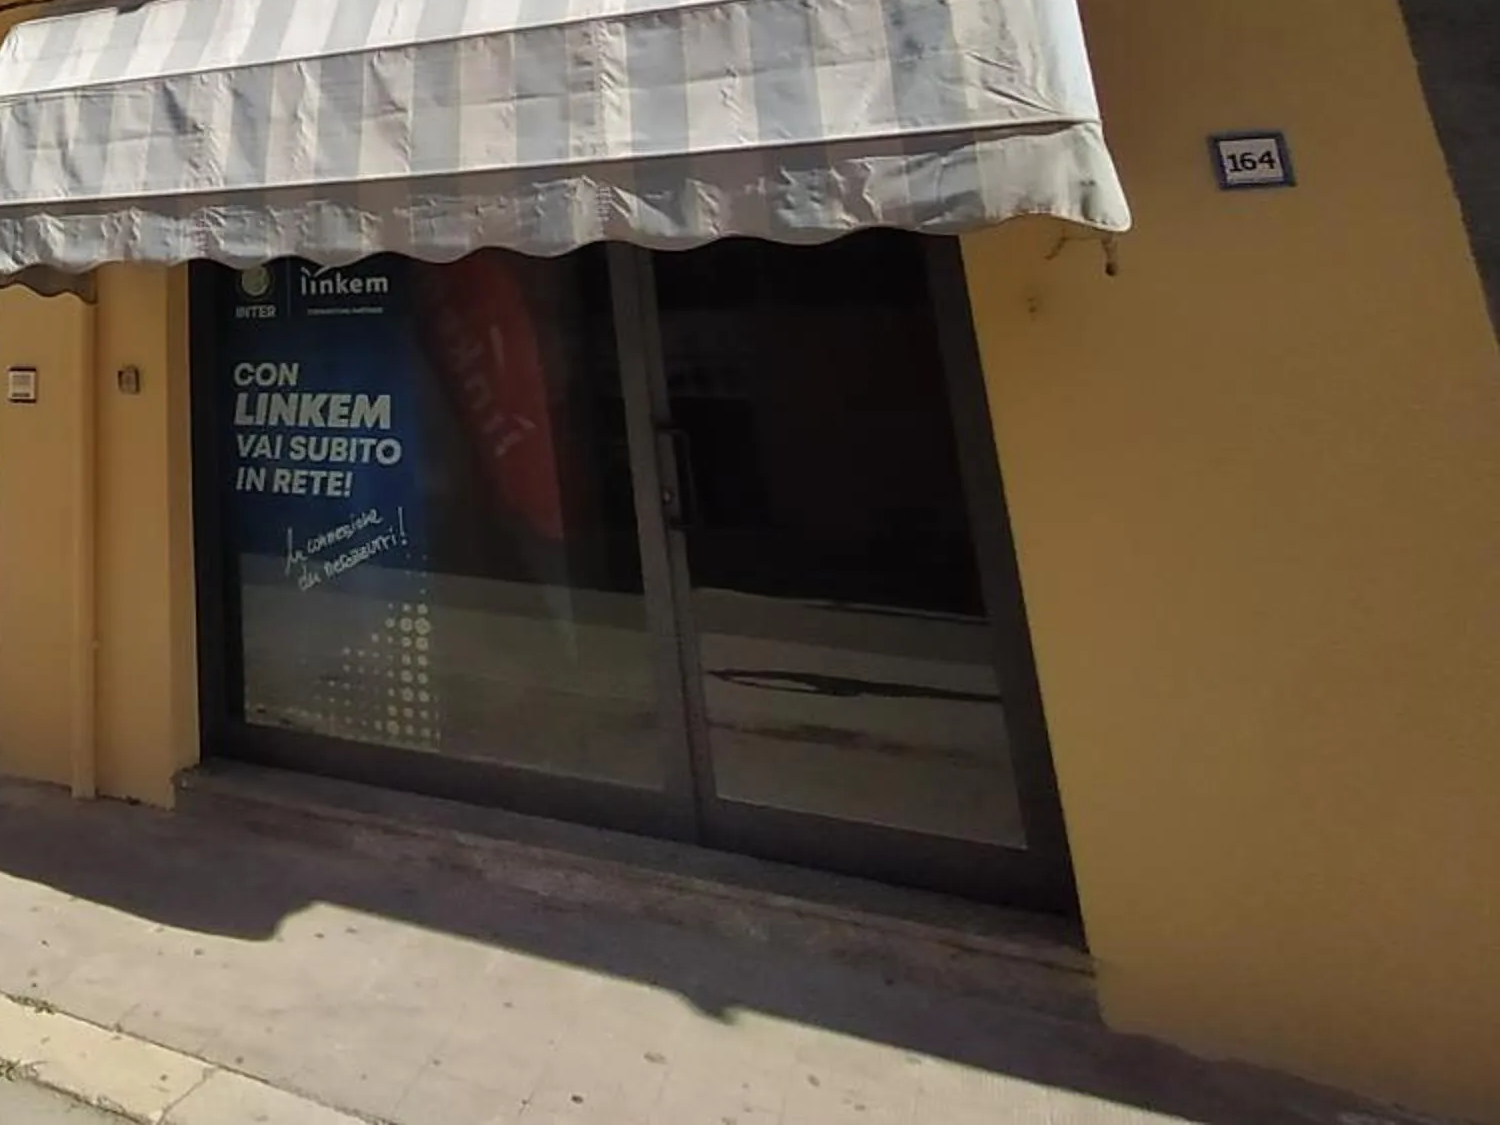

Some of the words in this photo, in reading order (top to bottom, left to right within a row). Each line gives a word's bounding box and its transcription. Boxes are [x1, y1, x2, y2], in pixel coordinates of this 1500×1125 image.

[1226, 150, 1276, 173] 164
[300, 266, 389, 295] linkem
[233, 362, 300, 387] CON
[233, 392, 391, 429] LINKEM
[235, 435, 283, 460] VAI
[288, 436, 402, 464] SUBITO
[235, 468, 265, 491] IN
[273, 469, 353, 497] RETE!
